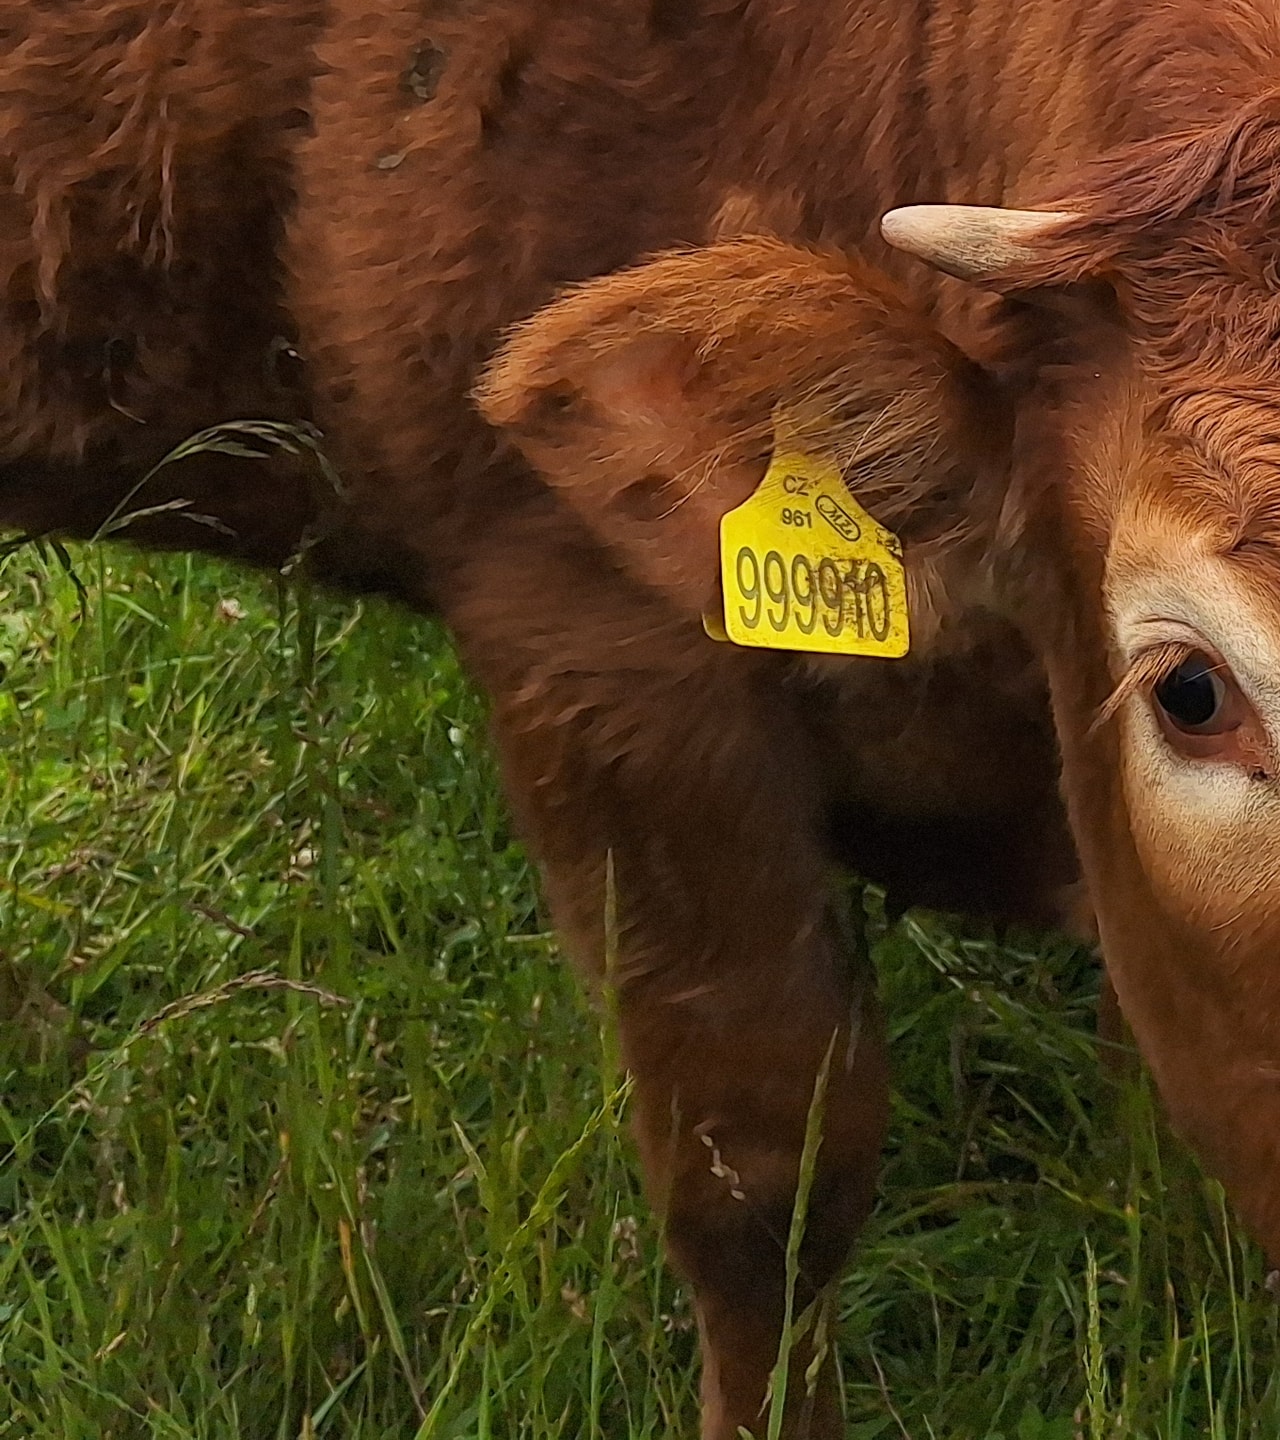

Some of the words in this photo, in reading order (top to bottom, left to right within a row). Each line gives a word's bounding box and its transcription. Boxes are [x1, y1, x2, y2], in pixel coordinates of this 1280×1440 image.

[783, 475, 809, 496] CZ
[782, 508, 813, 529] 961
[736, 546, 891, 642] 999910
